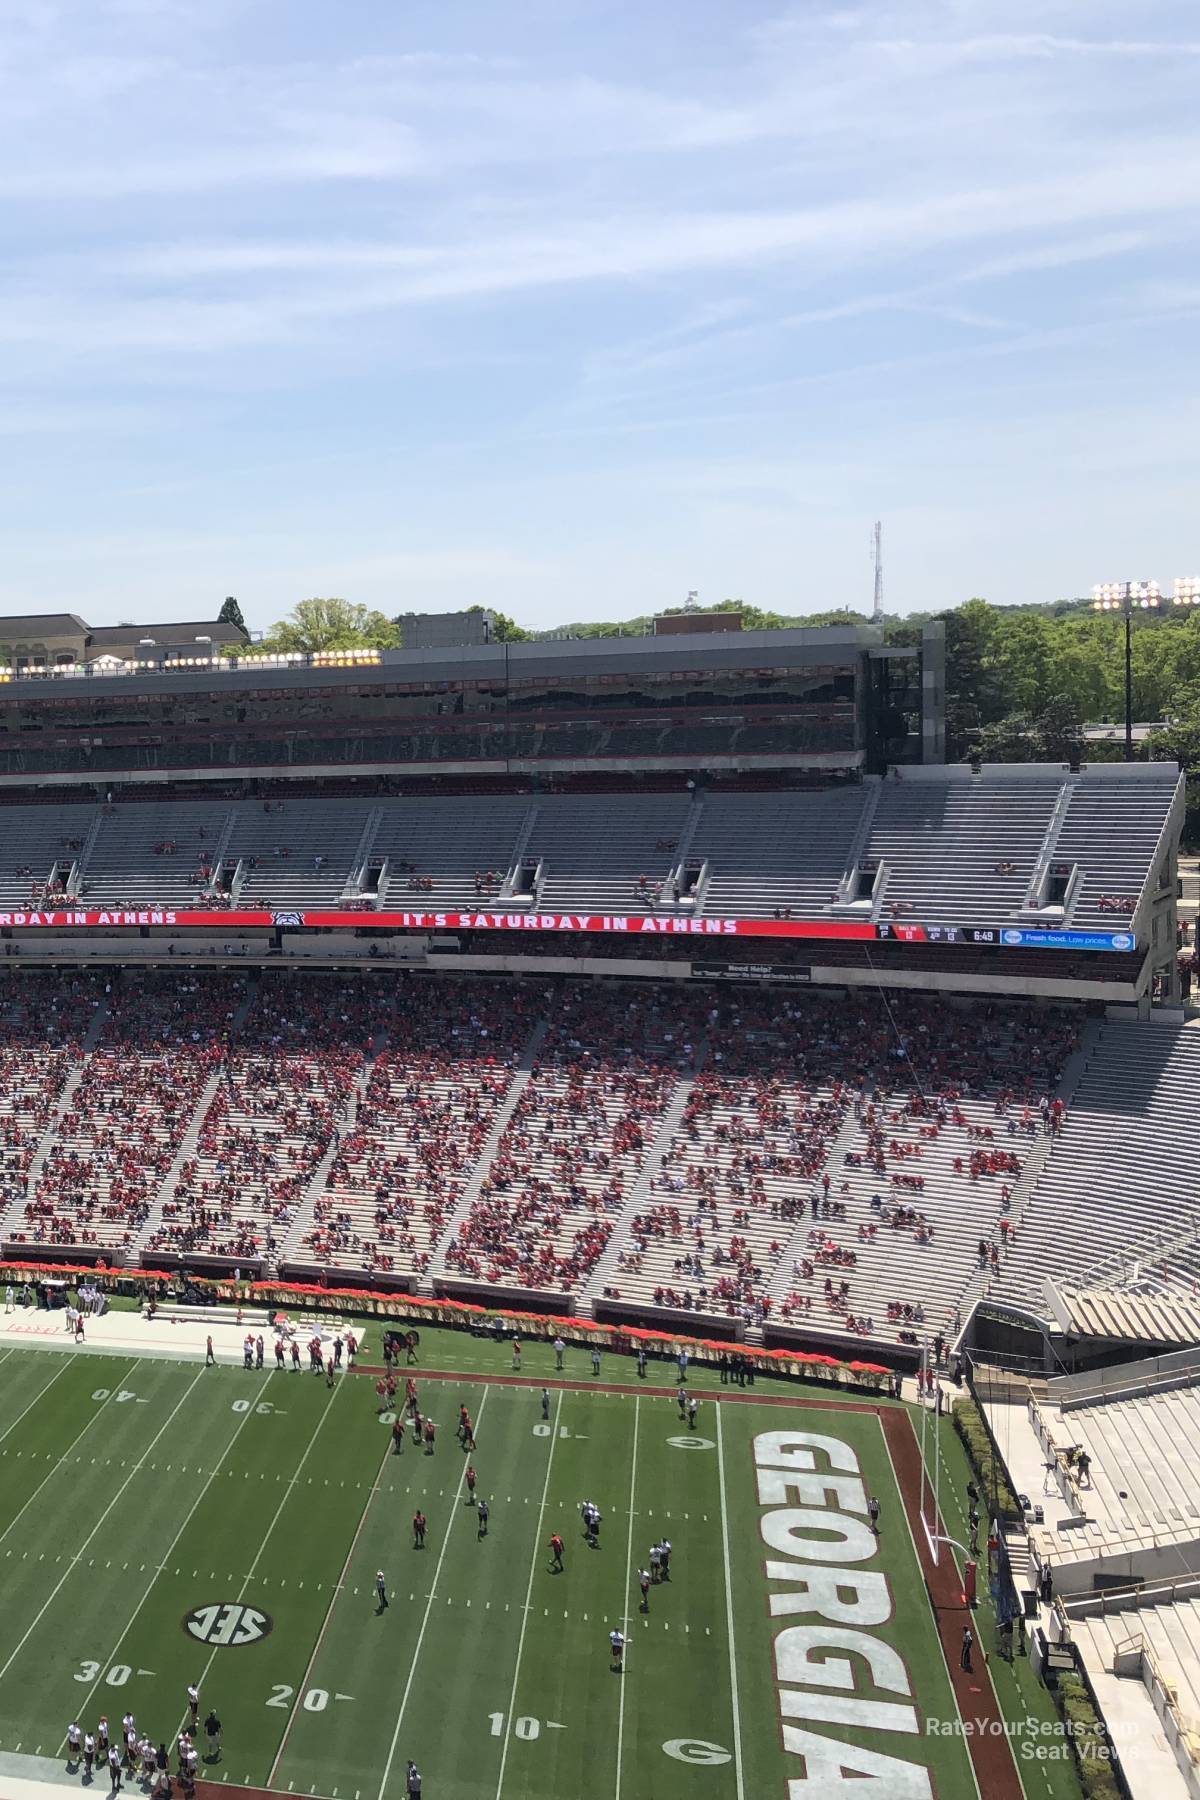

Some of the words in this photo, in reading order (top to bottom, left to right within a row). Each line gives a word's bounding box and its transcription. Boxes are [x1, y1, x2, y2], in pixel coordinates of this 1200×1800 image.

[66, 912, 87, 925] IN
[98, 911, 177, 924] ATHENS
[402, 913, 447, 926] IT'S
[459, 914, 592, 929] SATURDAY
[603, 917, 628, 930] IN
[641, 918, 737, 933] ATHENS
[973, 930, 994, 941] 6:49
[1025, 933, 1047, 942] Fresh
[1068, 935, 1083, 943] Low
[91, 1388, 136, 1403] 40
[231, 1399, 275, 1415] 30
[533, 1424, 574, 1439] 10
[753, 1430, 936, 1800] GEORGIA
[187, 1604, 268, 1645] SEC
[73, 1660, 133, 1687] 30
[265, 1684, 330, 1712] 20
[487, 1712, 541, 1741] 10
